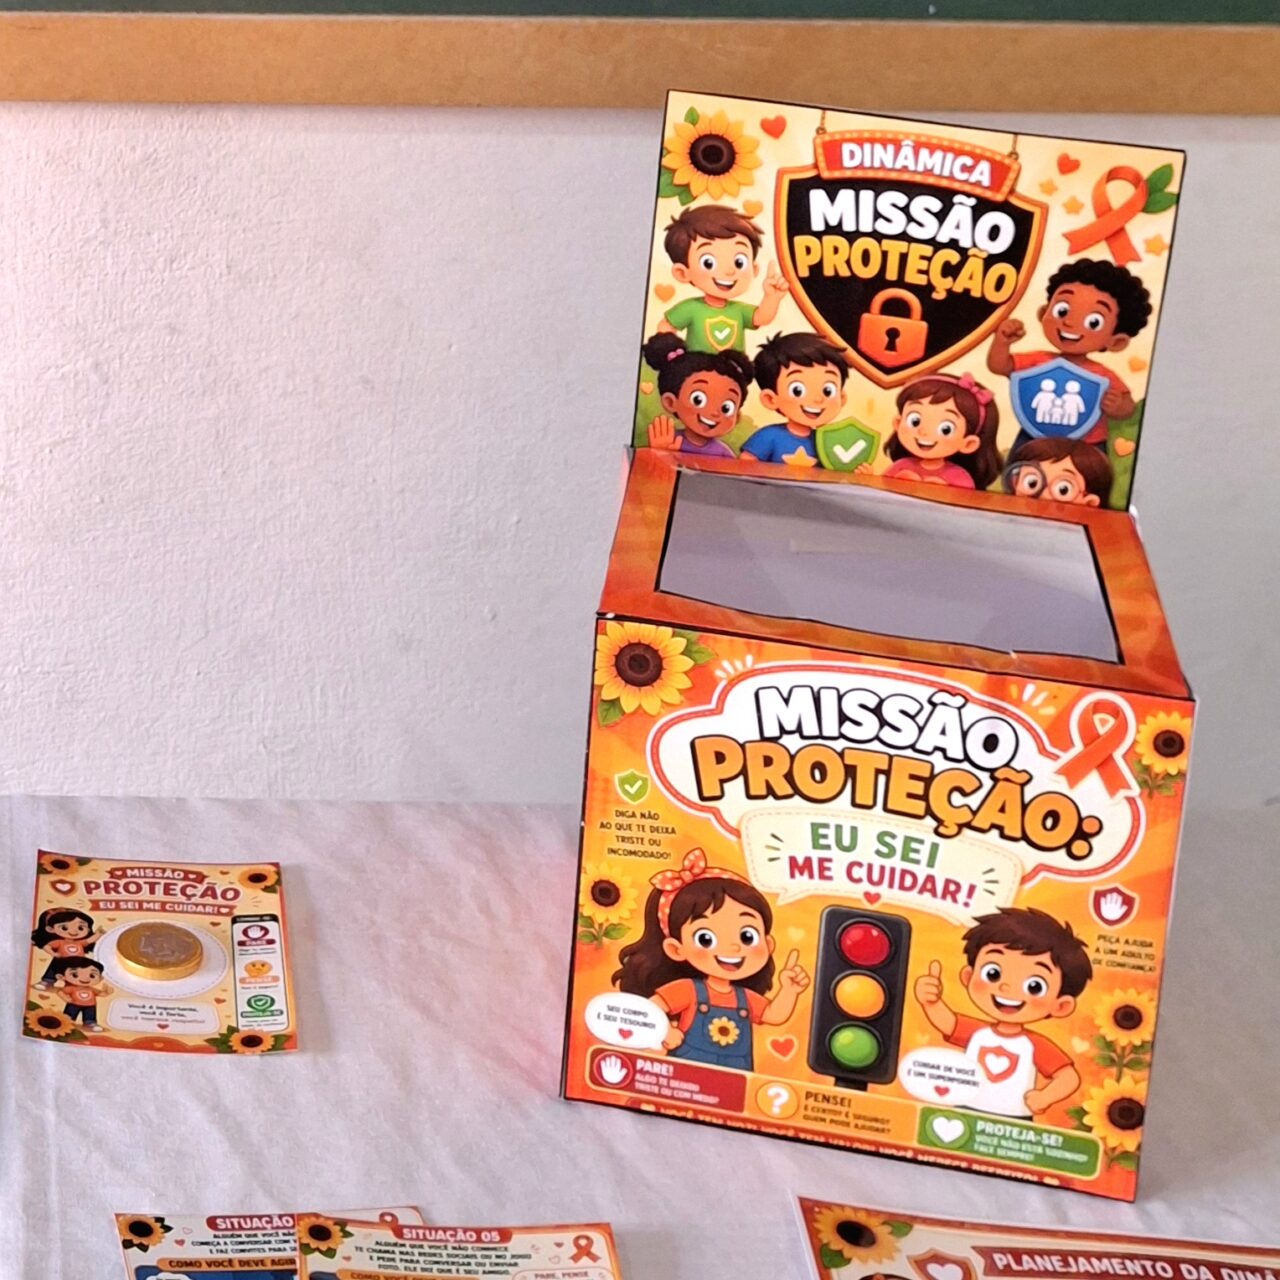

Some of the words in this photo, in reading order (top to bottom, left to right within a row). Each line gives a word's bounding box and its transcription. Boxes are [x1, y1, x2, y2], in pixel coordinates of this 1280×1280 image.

[841, 140, 992, 187] DINÂMICA
[809, 188, 1016, 255] MISSÃO
[793, 235, 1017, 304] PROTEÇÃO
[753, 686, 1020, 771] MISSÃO
[690, 734, 1103, 861] PROTEÇÃO:
[615, 809, 637, 819] DIGA
[640, 810, 660, 820] NÃO
[615, 822, 632, 832] QUE
[636, 824, 646, 832] TE
[649, 825, 676, 834] DEIXA
[615, 835, 645, 846] TRISTE
[648, 838, 661, 846] OU
[811, 822, 858, 853] EU
[874, 830, 940, 868] SEI
[126, 867, 185, 881] MISSÃO
[789, 856, 834, 881] ME
[846, 860, 977, 908] CUIDAR!
[83, 880, 241, 902] PROTEÇÃO
[99, 900, 117, 910] EU
[120, 901, 139, 910] SEI
[142, 901, 162, 911] ME
[166, 902, 219, 914] CUIDAR!
[636, 1058, 674, 1076] PARE!
[975, 1120, 1064, 1147] PROTEJA-SE!
[216, 1214, 294, 1230] SITUAÇÃO
[402, 1227, 477, 1243] SITUAÇÃO
[481, 1230, 501, 1242] 05
[168, 1259, 202, 1268] COMO
[205, 1258, 233, 1268] VOCÊ
[238, 1259, 265, 1268] DEVE
[992, 1253, 1174, 1278] PLANEJAMENTO
[1179, 1263, 1216, 1280] DA
